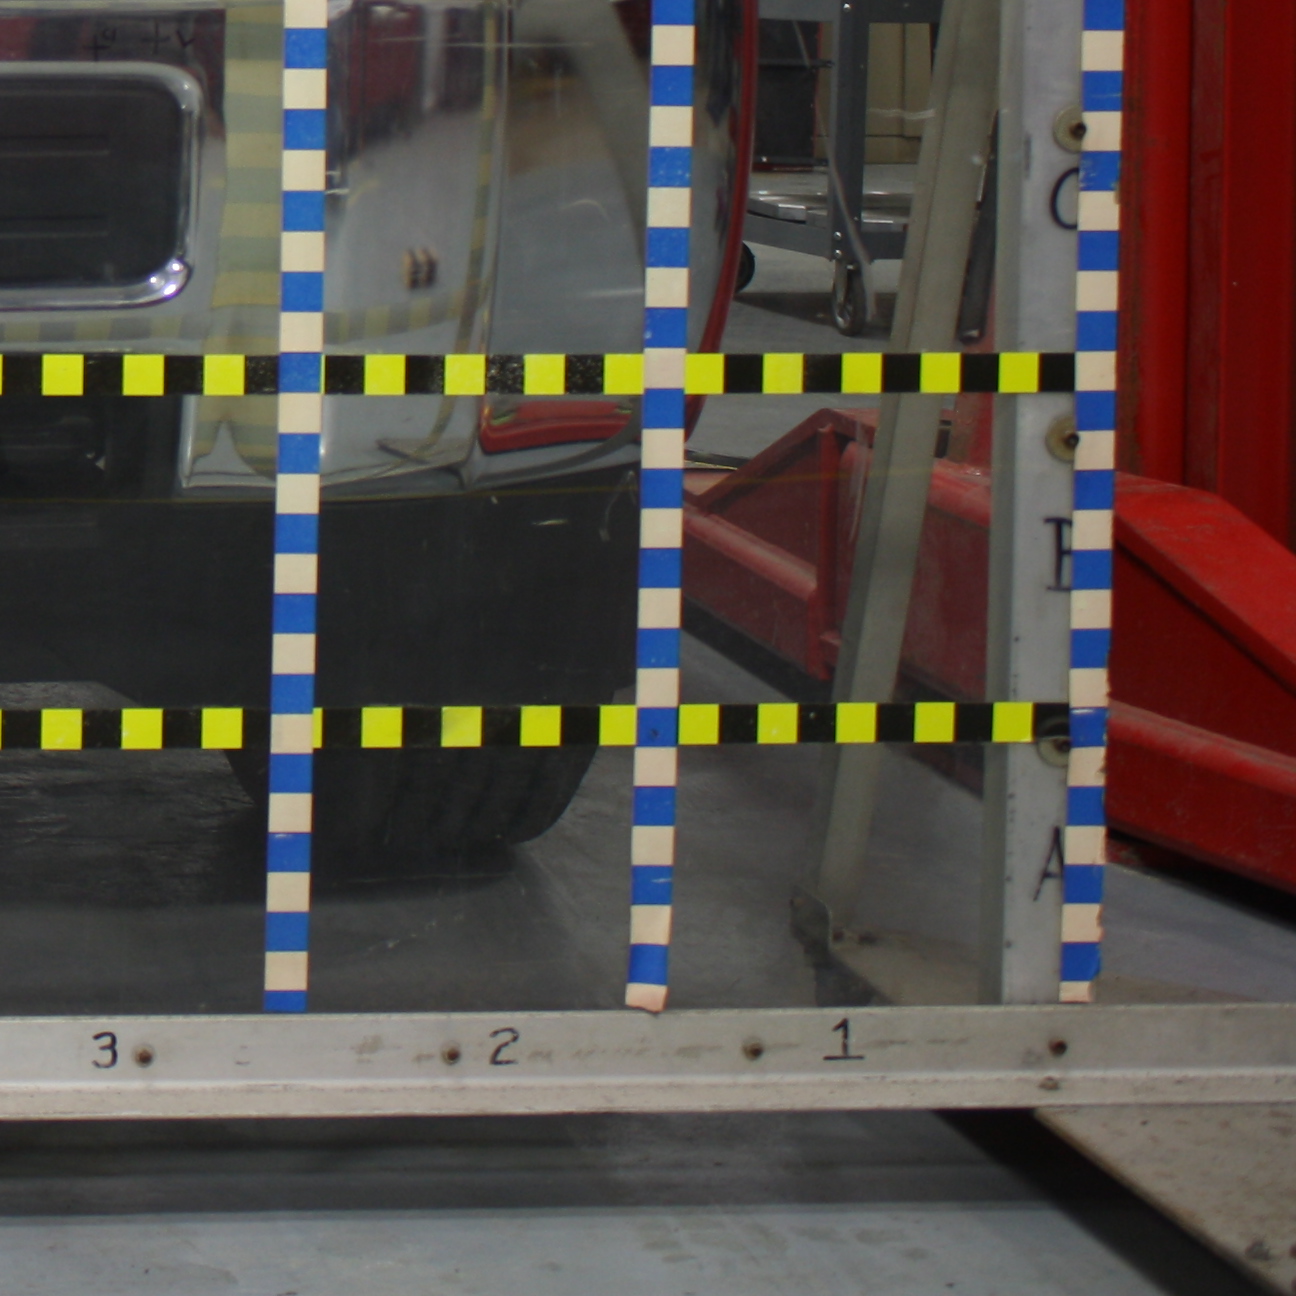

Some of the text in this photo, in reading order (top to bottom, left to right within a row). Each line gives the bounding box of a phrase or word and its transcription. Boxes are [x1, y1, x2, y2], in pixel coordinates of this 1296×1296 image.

[93, 1030, 119, 1071] 3
[489, 1027, 521, 1067] 2
[821, 1017, 866, 1062] 1
